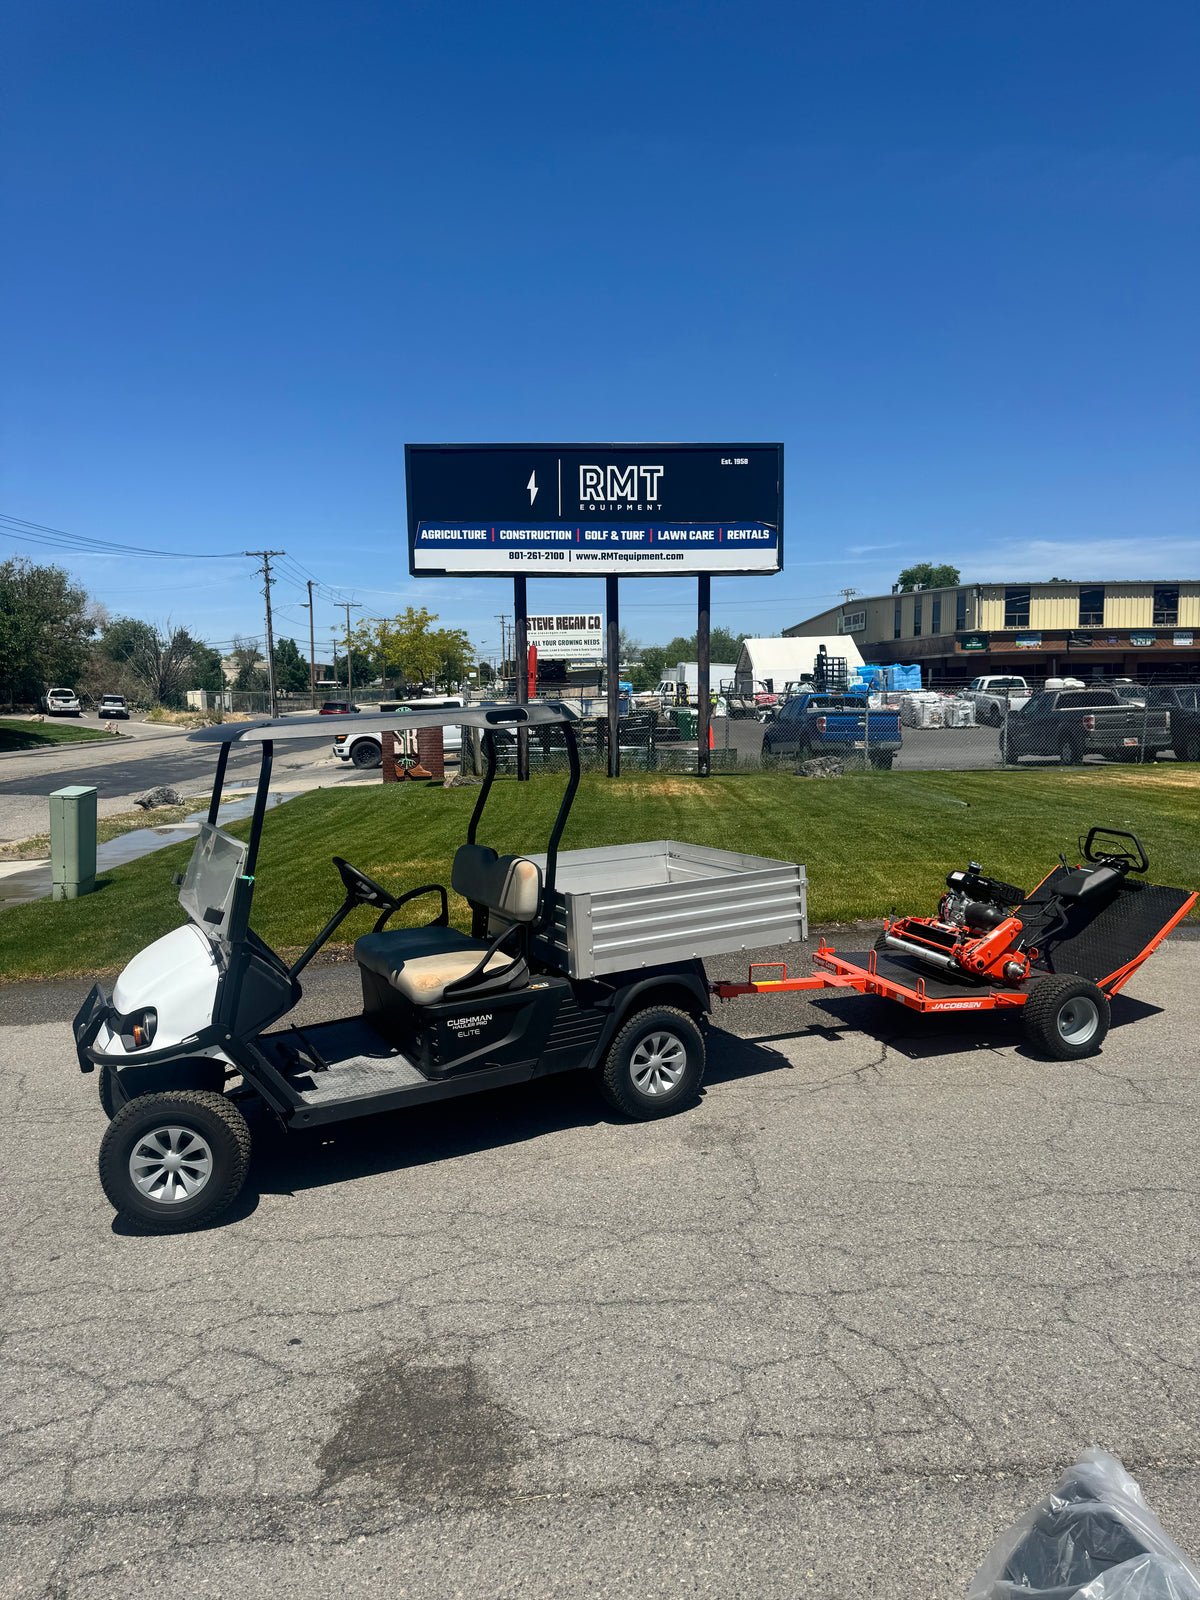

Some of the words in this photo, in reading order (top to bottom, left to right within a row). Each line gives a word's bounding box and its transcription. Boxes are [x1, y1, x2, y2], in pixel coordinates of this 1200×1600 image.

[579, 465, 664, 501] RMT
[421, 529, 487, 540] AGRICULTURE
[500, 530, 572, 540] CONSTRUCTION
[584, 530, 609, 540] GOLF
[610, 530, 619, 540] &
[620, 530, 645, 540] TURF
[657, 530, 687, 540] LAWN
[688, 530, 715, 540] CARE
[727, 529, 770, 540] RENTALS
[508, 551, 565, 560] 801-261-2100
[575, 552, 684, 562] www.RMTequipment.com
[526, 616, 554, 631] STEVE
[556, 616, 586, 630] REGAN
[931, 1001, 982, 1010] JACOBSEN
[447, 1014, 492, 1026] CUSHMAN
[458, 1028, 480, 1037] ELITE
